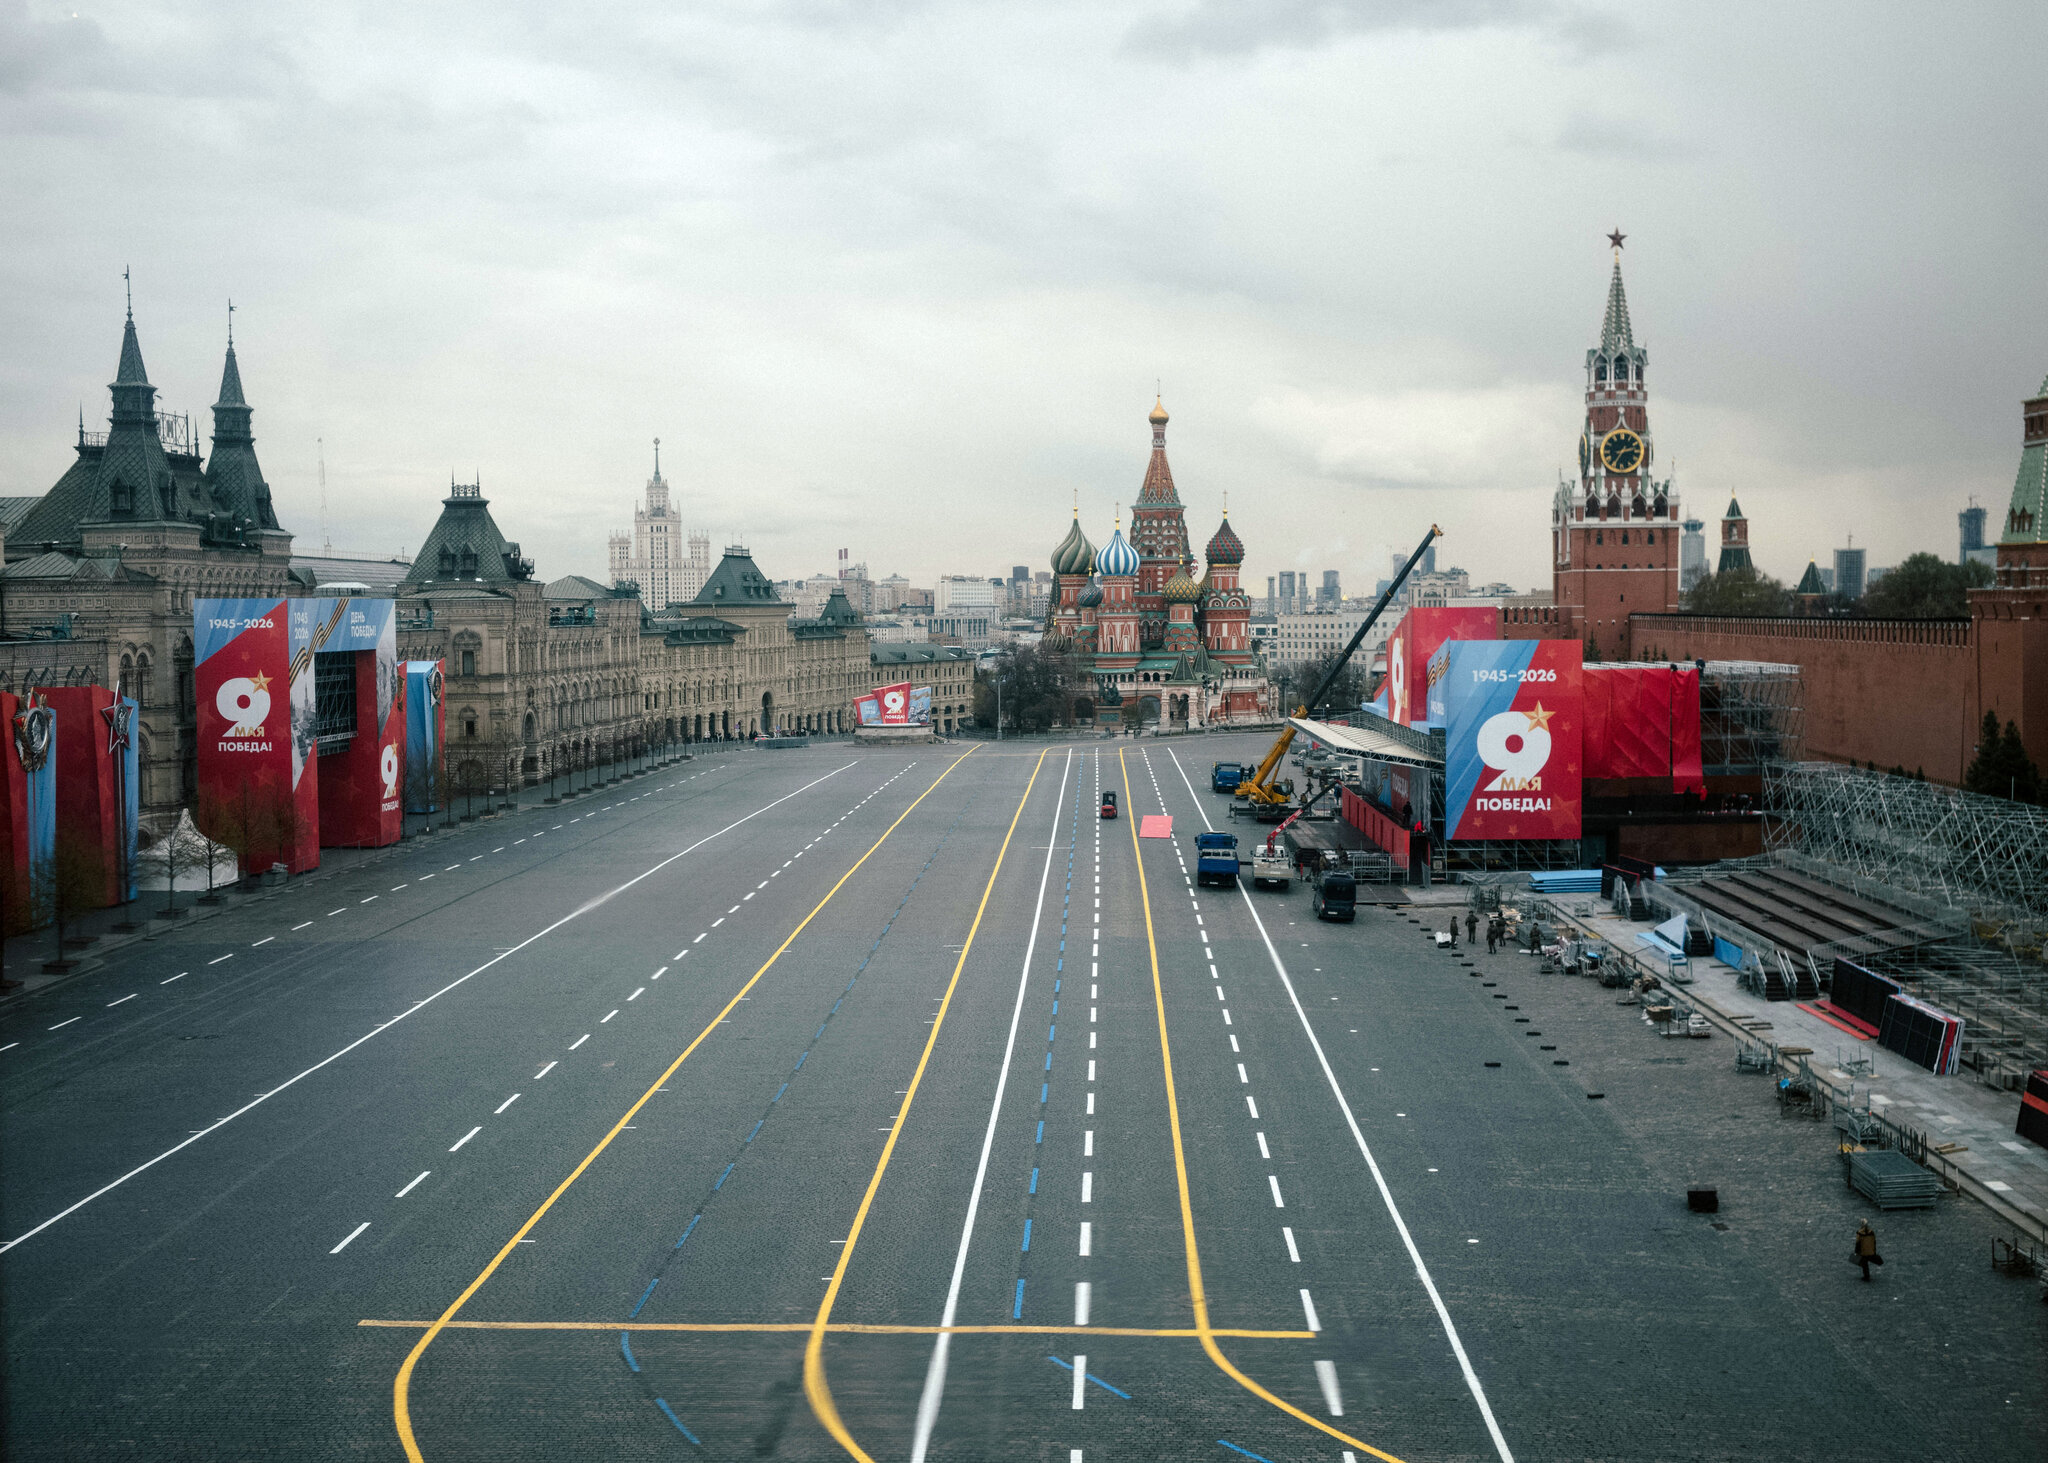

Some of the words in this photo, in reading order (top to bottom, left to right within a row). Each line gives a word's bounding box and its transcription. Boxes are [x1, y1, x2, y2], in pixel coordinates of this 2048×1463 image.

[294, 612, 308, 624] 1945
[350, 612, 366, 624] ДЕНЬ
[294, 627, 309, 639] 2026
[351, 625, 377, 639] ПОБЕДЫ!
[215, 677, 271, 737] 9
[884, 691, 905, 714] 9
[234, 726, 265, 737] МАЯ
[218, 742, 273, 753] ПОБЕДА!
[1476, 711, 1552, 792] 9
[381, 744, 398, 799] 9
[1500, 777, 1542, 792] МАЯ
[1476, 798, 1552, 813] ПОБЕДА!
